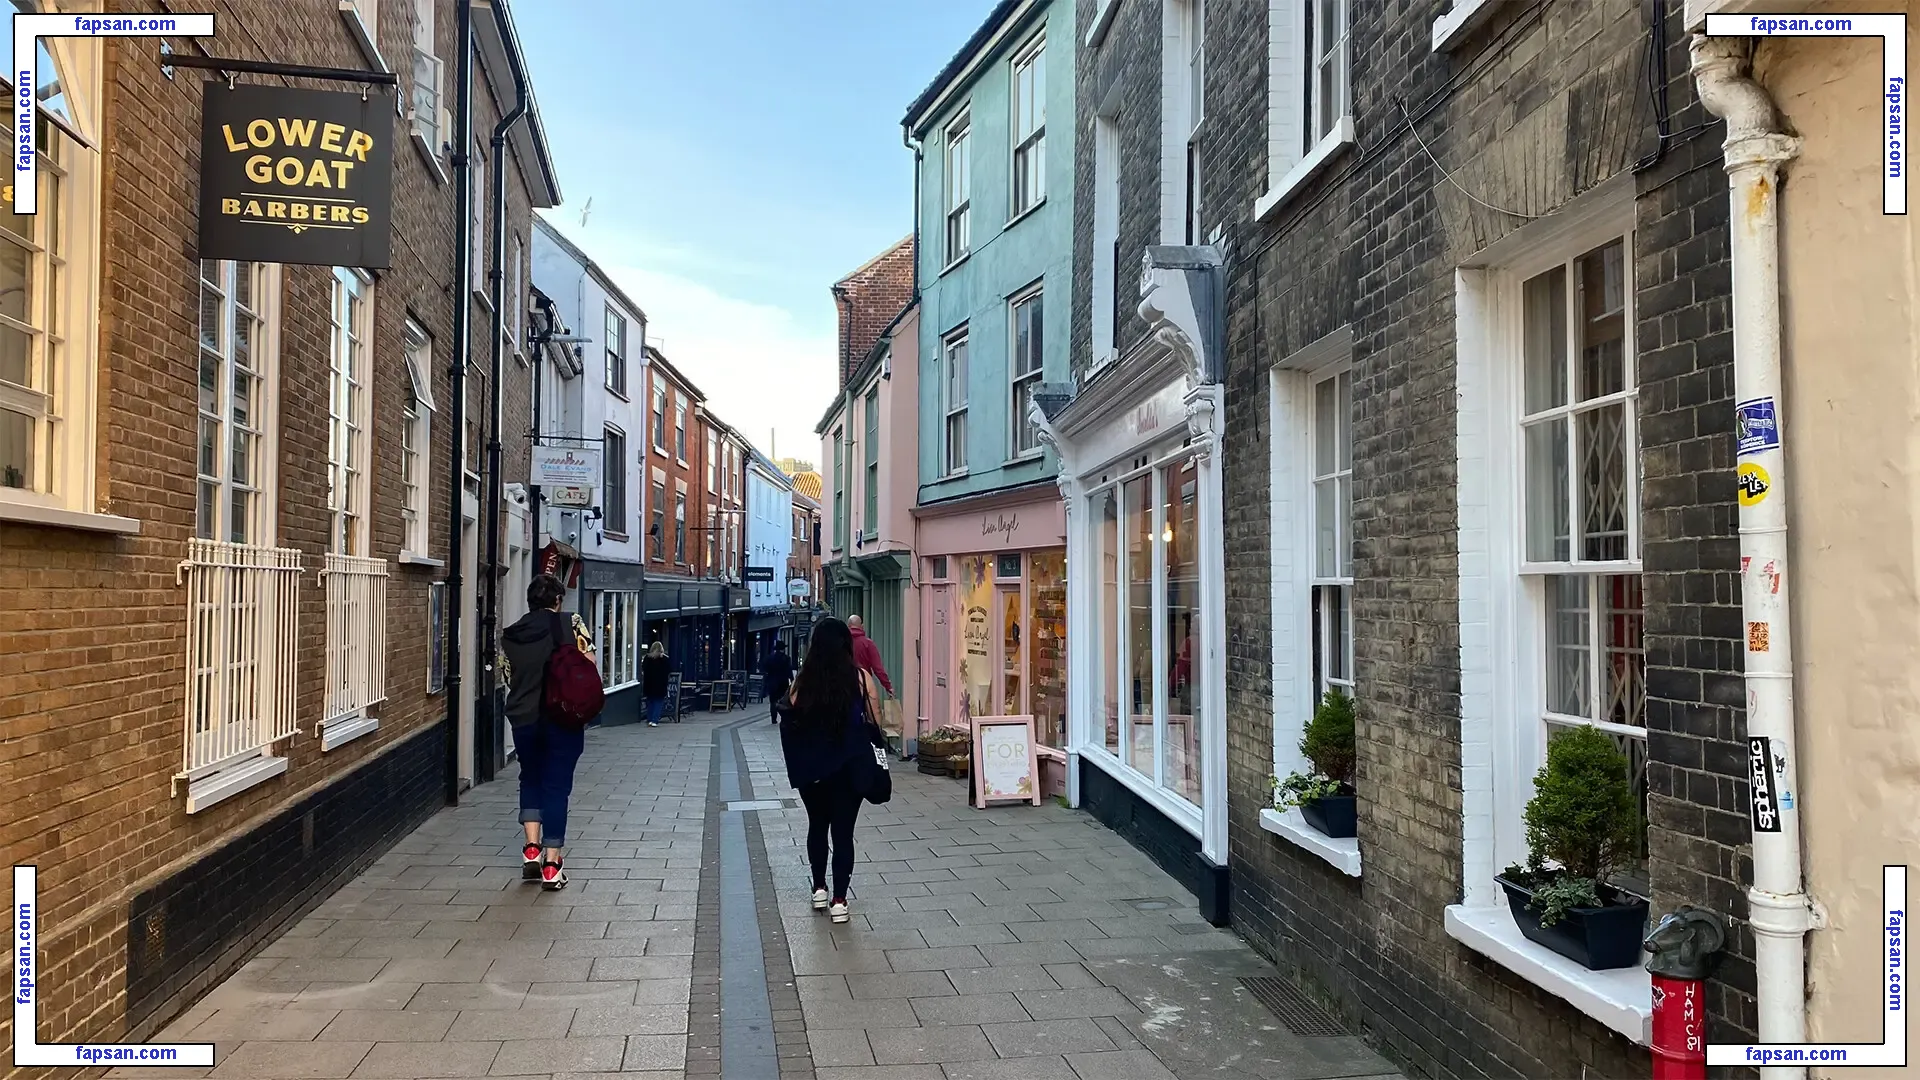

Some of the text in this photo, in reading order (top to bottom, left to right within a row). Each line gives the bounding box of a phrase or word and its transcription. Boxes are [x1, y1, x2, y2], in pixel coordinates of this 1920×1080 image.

[222, 118, 373, 162] LOWER
[245, 155, 353, 189] GOAT
[222, 198, 369, 223] BARBERS
[986, 743, 1025, 758] FOR
